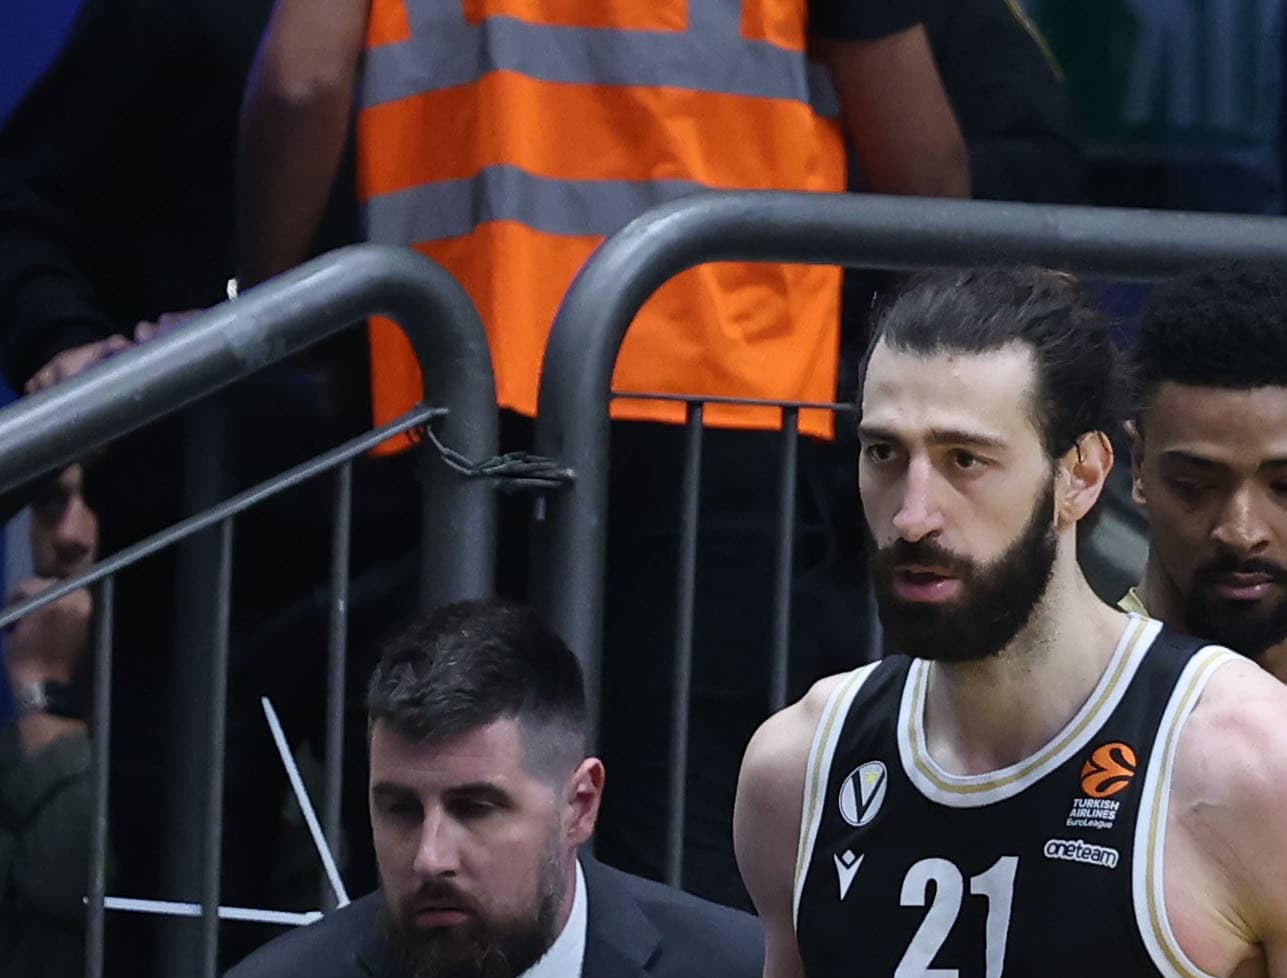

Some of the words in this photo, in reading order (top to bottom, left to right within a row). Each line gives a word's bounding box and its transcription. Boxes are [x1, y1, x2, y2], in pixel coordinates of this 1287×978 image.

[1072, 798, 1120, 811] TURKISH
[1069, 808, 1116, 820] AIRLINES
[1044, 840, 1118, 867] oneteam
